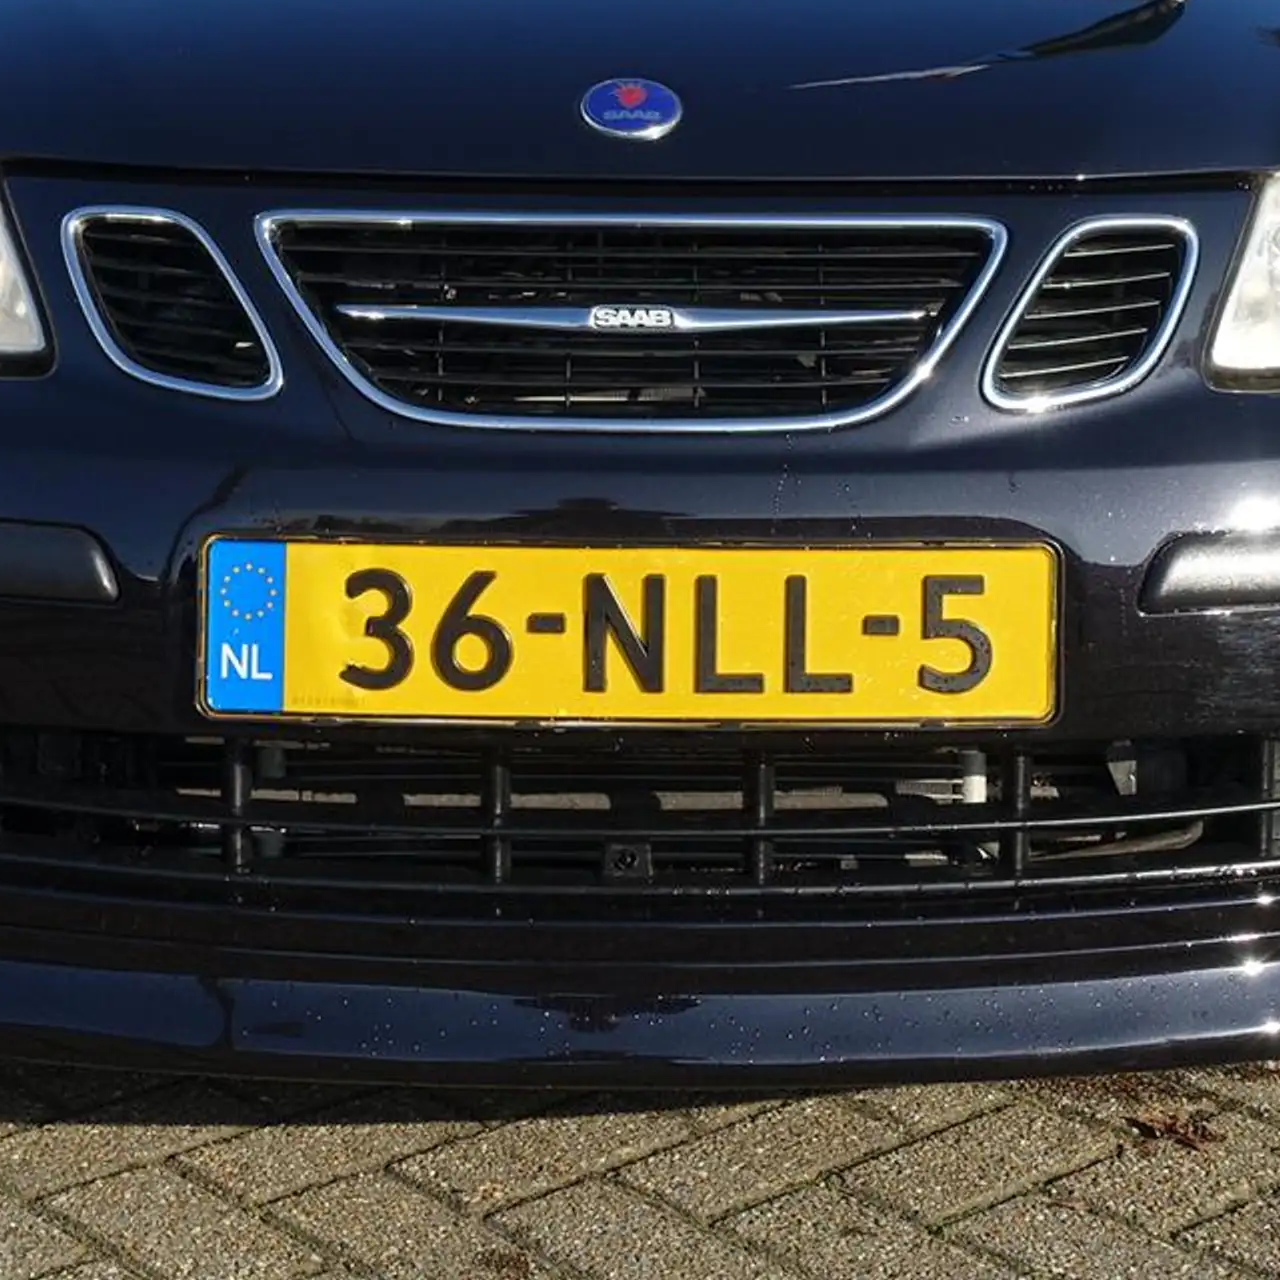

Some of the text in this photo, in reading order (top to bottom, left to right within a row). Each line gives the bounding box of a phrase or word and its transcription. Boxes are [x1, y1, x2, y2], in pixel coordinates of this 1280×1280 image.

[595, 308, 672, 328] SAAB
[339, 569, 994, 695] 36-NLL-5
[221, 642, 273, 680] NL
